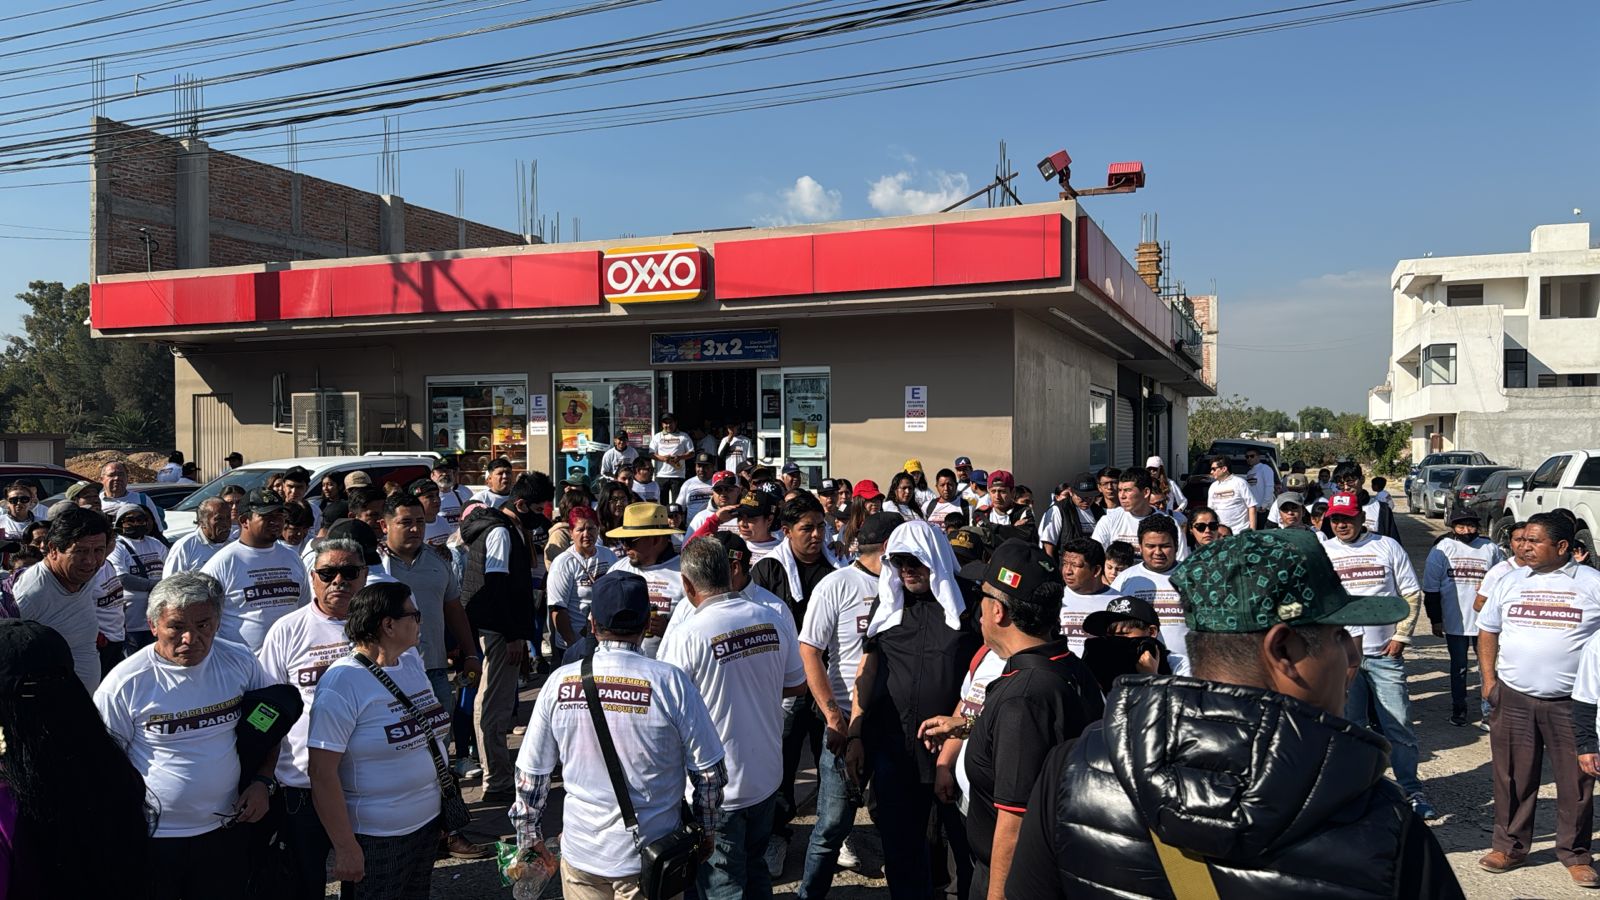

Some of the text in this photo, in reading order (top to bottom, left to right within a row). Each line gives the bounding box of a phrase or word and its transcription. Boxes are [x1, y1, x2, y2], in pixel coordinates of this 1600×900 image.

[607, 250, 696, 295] OXXO
[703, 338, 743, 356] 3x2
[911, 387, 921, 400] E
[535, 396, 543, 407] E
[1353, 570, 1384, 578] PARQUE
[246, 588, 260, 599] SI
[1509, 606, 1523, 616] SI
[1539, 610, 1580, 619] PARQUE
[859, 619, 868, 629] S
[714, 634, 779, 656] SI AL PARQUE
[309, 649, 338, 657] PARQUE
[300, 671, 317, 683] SI
[560, 685, 649, 702] SI A PARQUE
[188, 708, 201, 716] DE
[202, 696, 241, 713] DICIEMBR
[603, 703, 633, 713] PARQUE
[390, 725, 412, 739] SI
